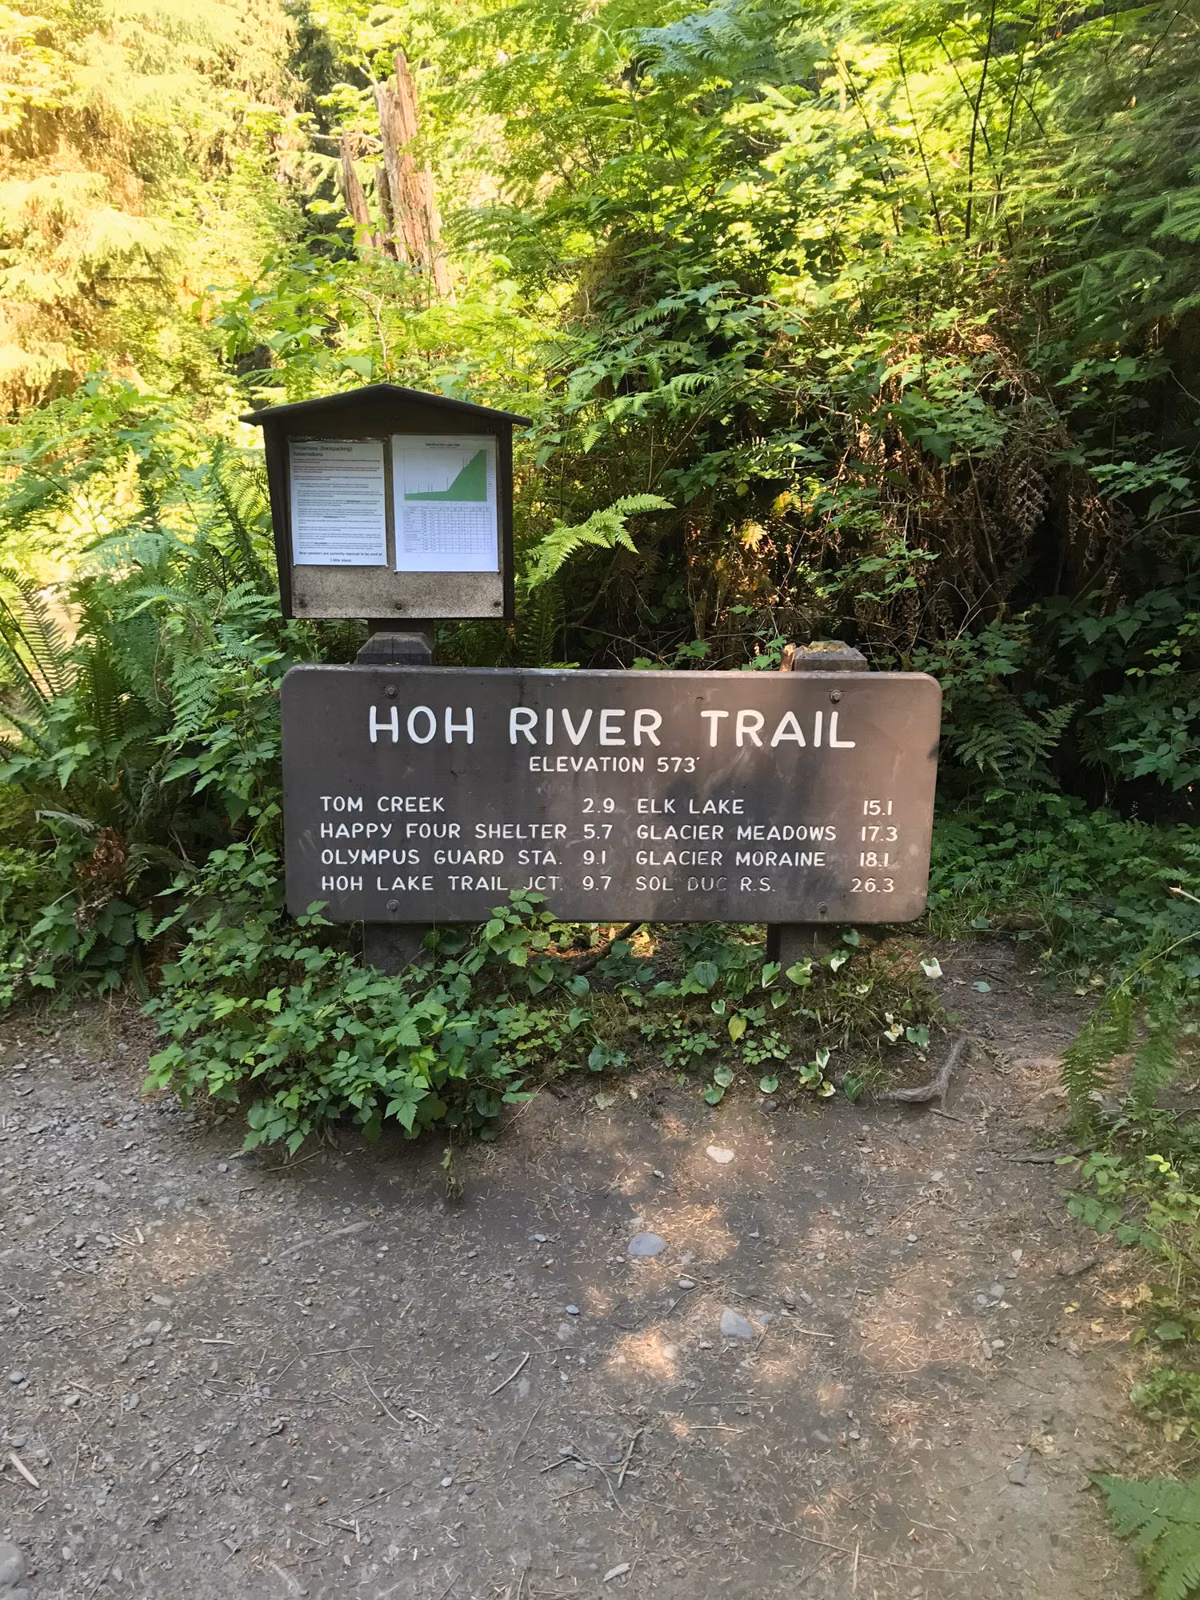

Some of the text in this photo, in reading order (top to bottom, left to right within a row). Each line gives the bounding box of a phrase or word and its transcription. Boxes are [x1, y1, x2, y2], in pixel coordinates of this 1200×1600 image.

[369, 705, 856, 749] HOH RIVER TRAIL
[529, 755, 645, 773] ELEVATION
[320, 795, 615, 814] TOM CREEK 2.9
[637, 798, 893, 816] ELK LAKE 15.1
[320, 822, 612, 840] HAPPY FOUR SHELTER 5.7
[636, 824, 898, 842] GLACIER MEADOWS 17.3
[320, 848, 606, 866] OLYMPUS GUARD STA. 9.1
[635, 850, 889, 868] GLACIER MORAINE 18.1
[321, 875, 612, 892] HOH LAKE TRAIL JCT. 9.7
[635, 875, 895, 894] SOL DUC R.S. 26.3
